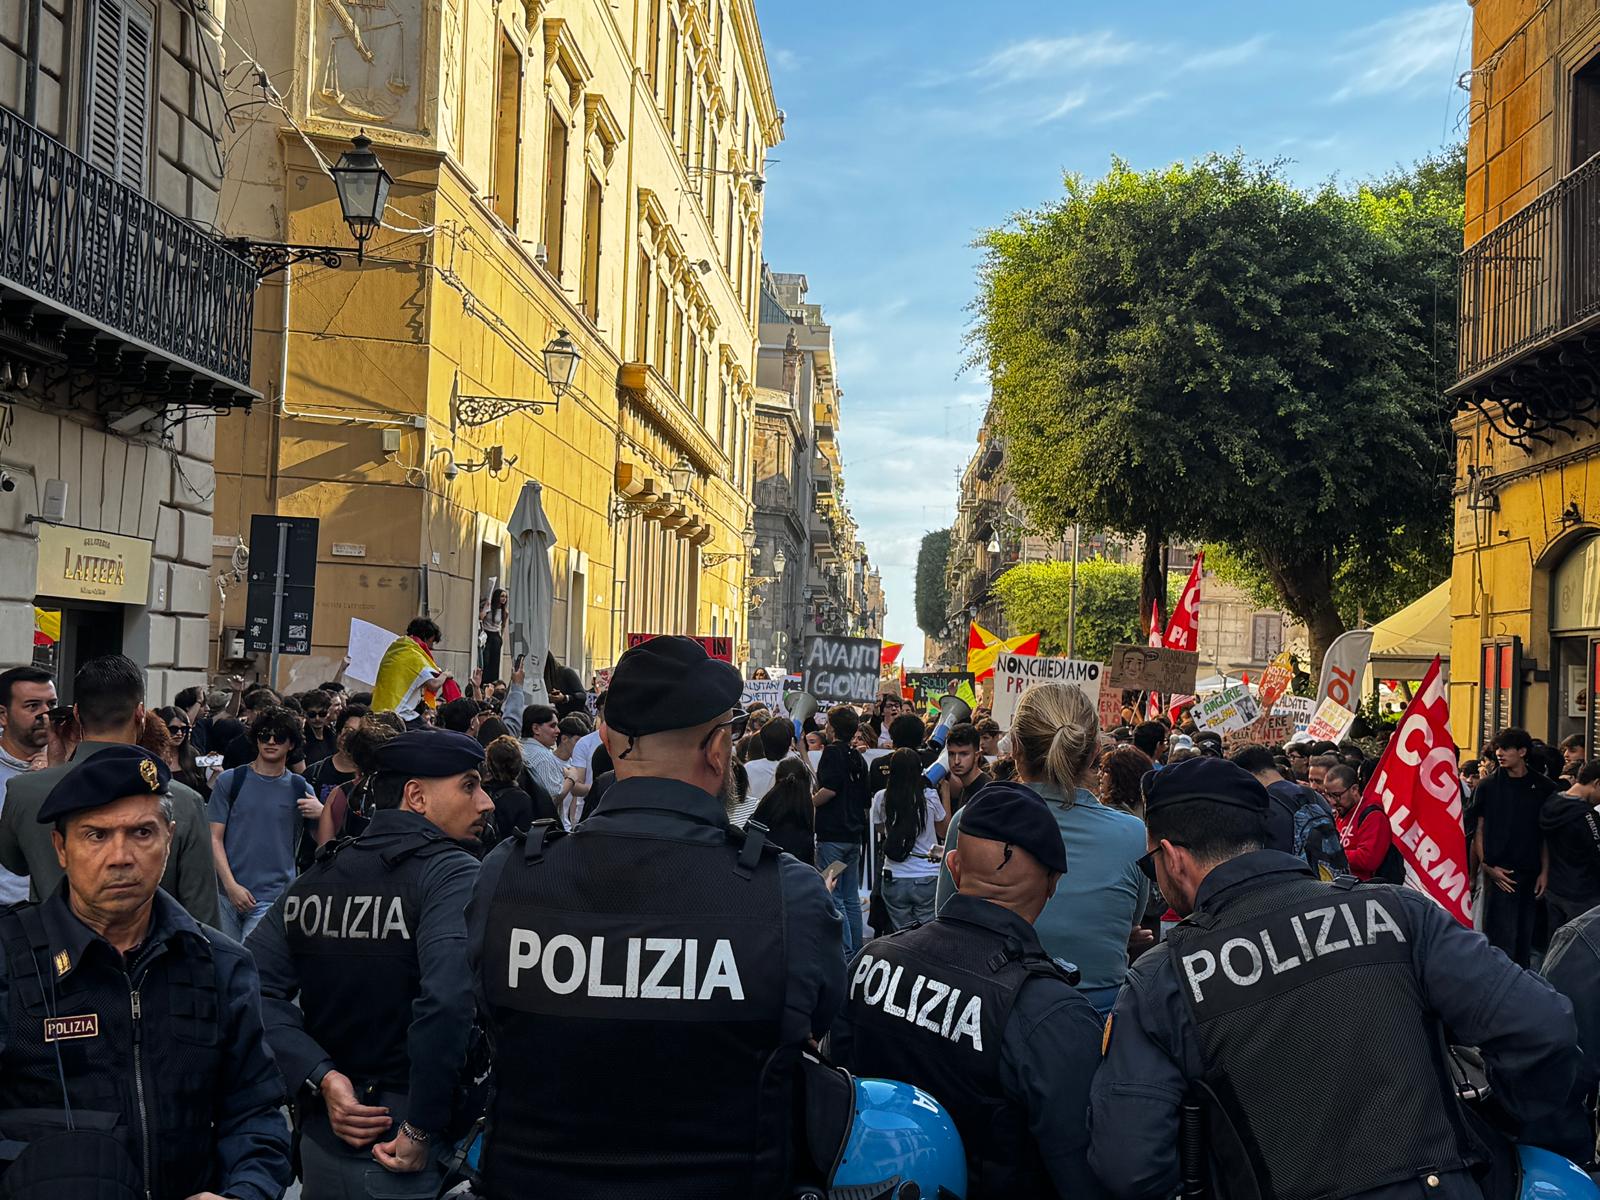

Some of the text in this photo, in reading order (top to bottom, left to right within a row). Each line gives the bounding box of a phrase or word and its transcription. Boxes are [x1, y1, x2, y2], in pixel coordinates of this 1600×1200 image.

[64, 547, 124, 585] LATTEPÀ
[712, 640, 727, 656] IN
[807, 637, 880, 670] AVANTI
[814, 670, 880, 702] GIOVANI
[1203, 685, 1243, 715] ANGURIE
[1396, 714, 1465, 834] CGI
[284, 894, 410, 939] POLIZIA
[1182, 899, 1406, 983] POLIZIA
[508, 927, 745, 1000] POLIZIA
[850, 954, 983, 1052] POLIZIA
[48, 1020, 94, 1035] POLIZIA
